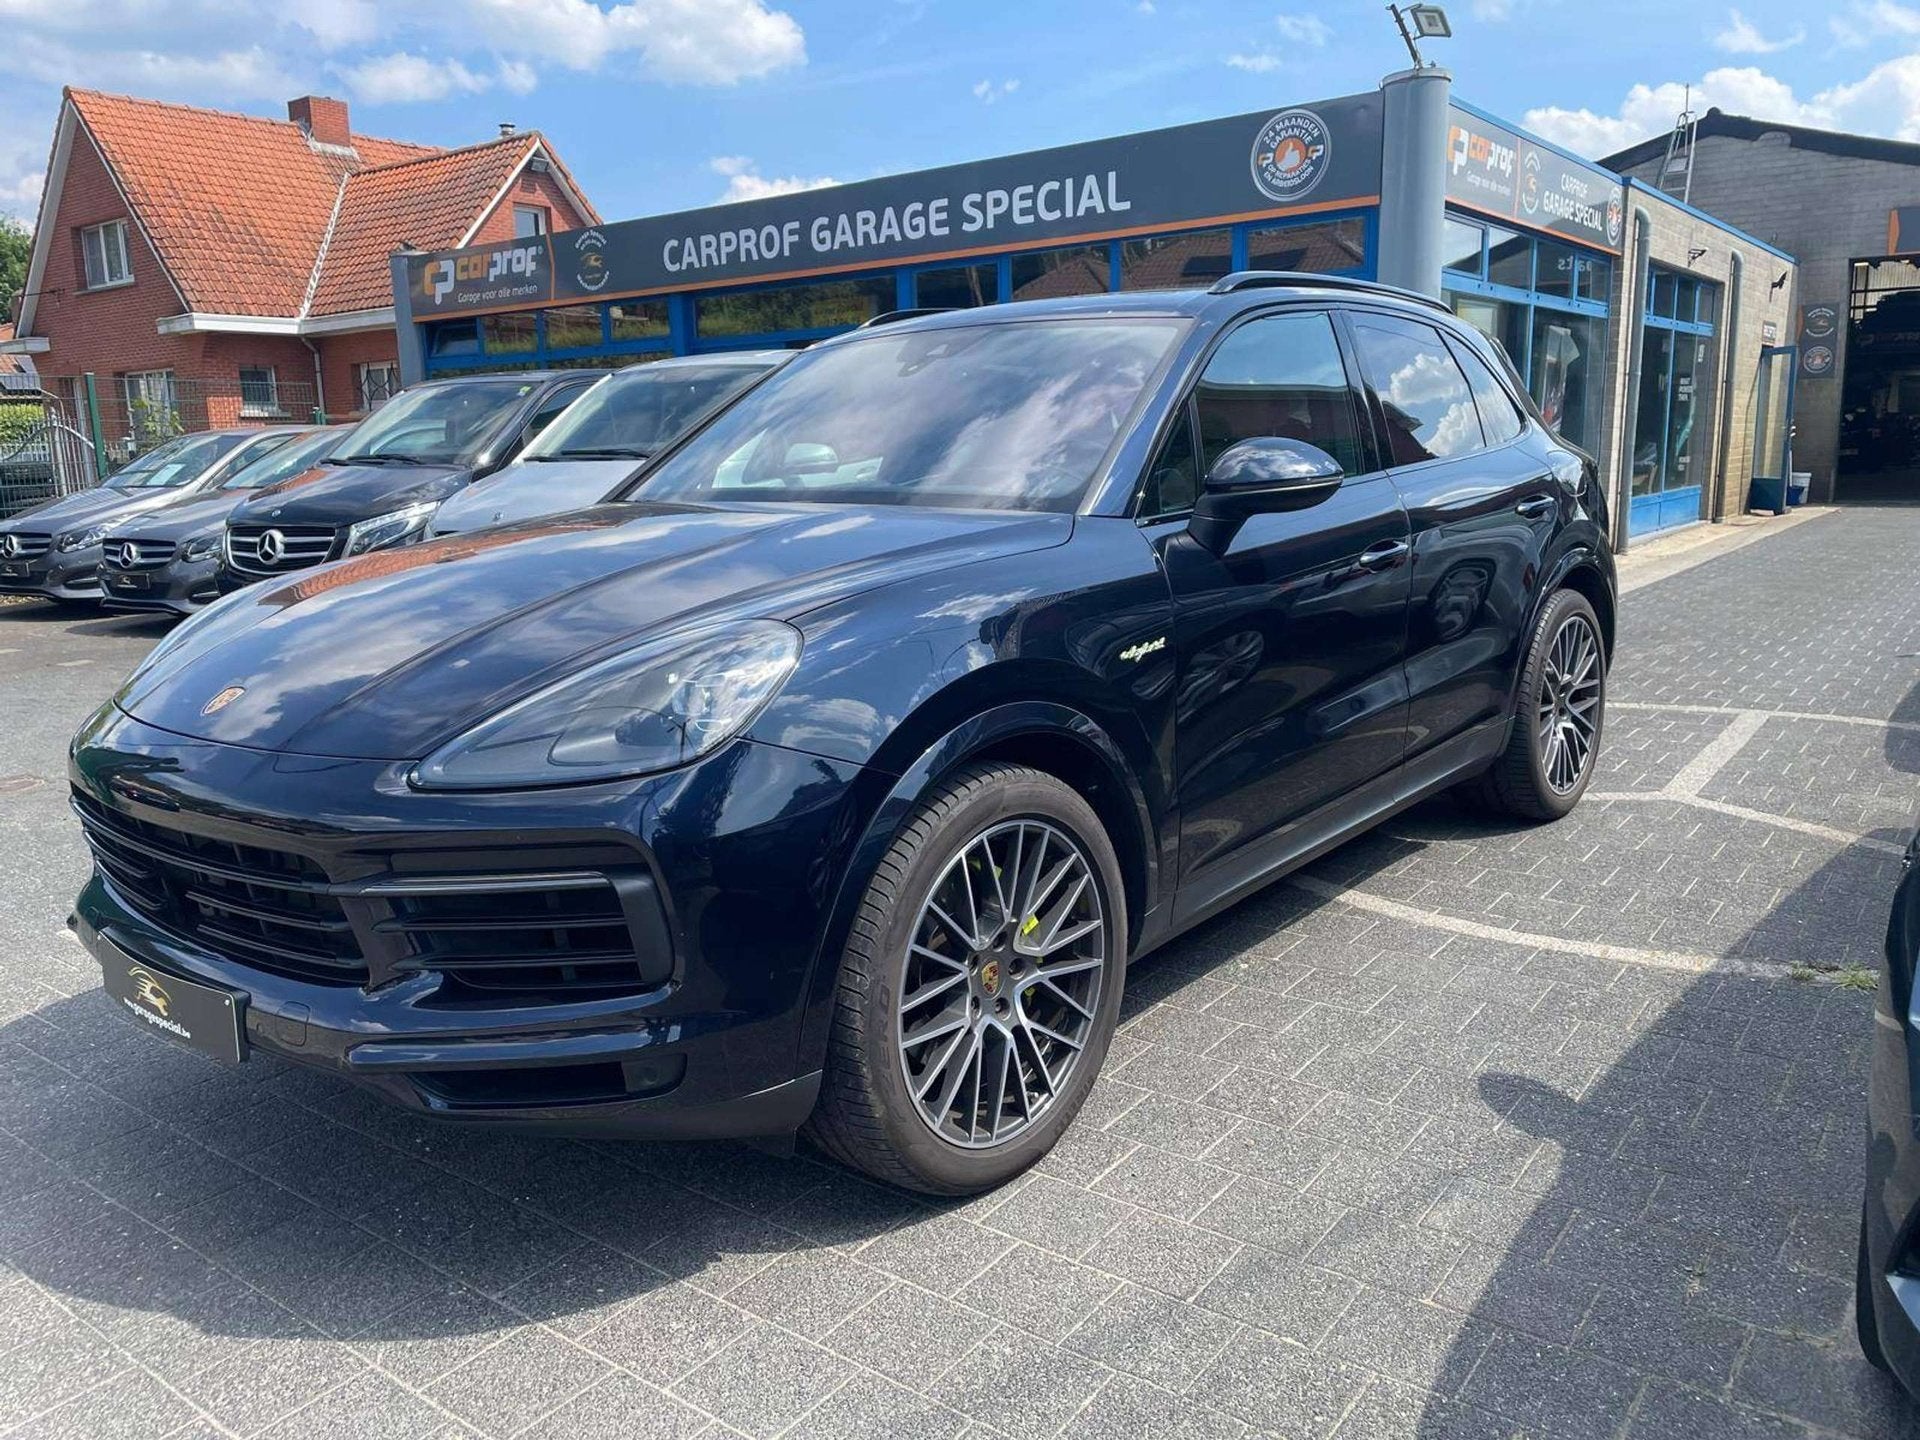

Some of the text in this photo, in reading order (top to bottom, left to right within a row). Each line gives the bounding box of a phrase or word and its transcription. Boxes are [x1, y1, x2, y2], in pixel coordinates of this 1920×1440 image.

[1263, 117, 1321, 144] 24 MAANDEN
[1270, 128, 1314, 149] GARANTIE
[662, 170, 1131, 273] CARPROF GARAGE SPECIAL
[1543, 190, 1575, 220] GARAGE
[1574, 202, 1603, 231] SPECIAL
[456, 246, 537, 282] carprof
[458, 284, 537, 304] Garage voor alle merken
